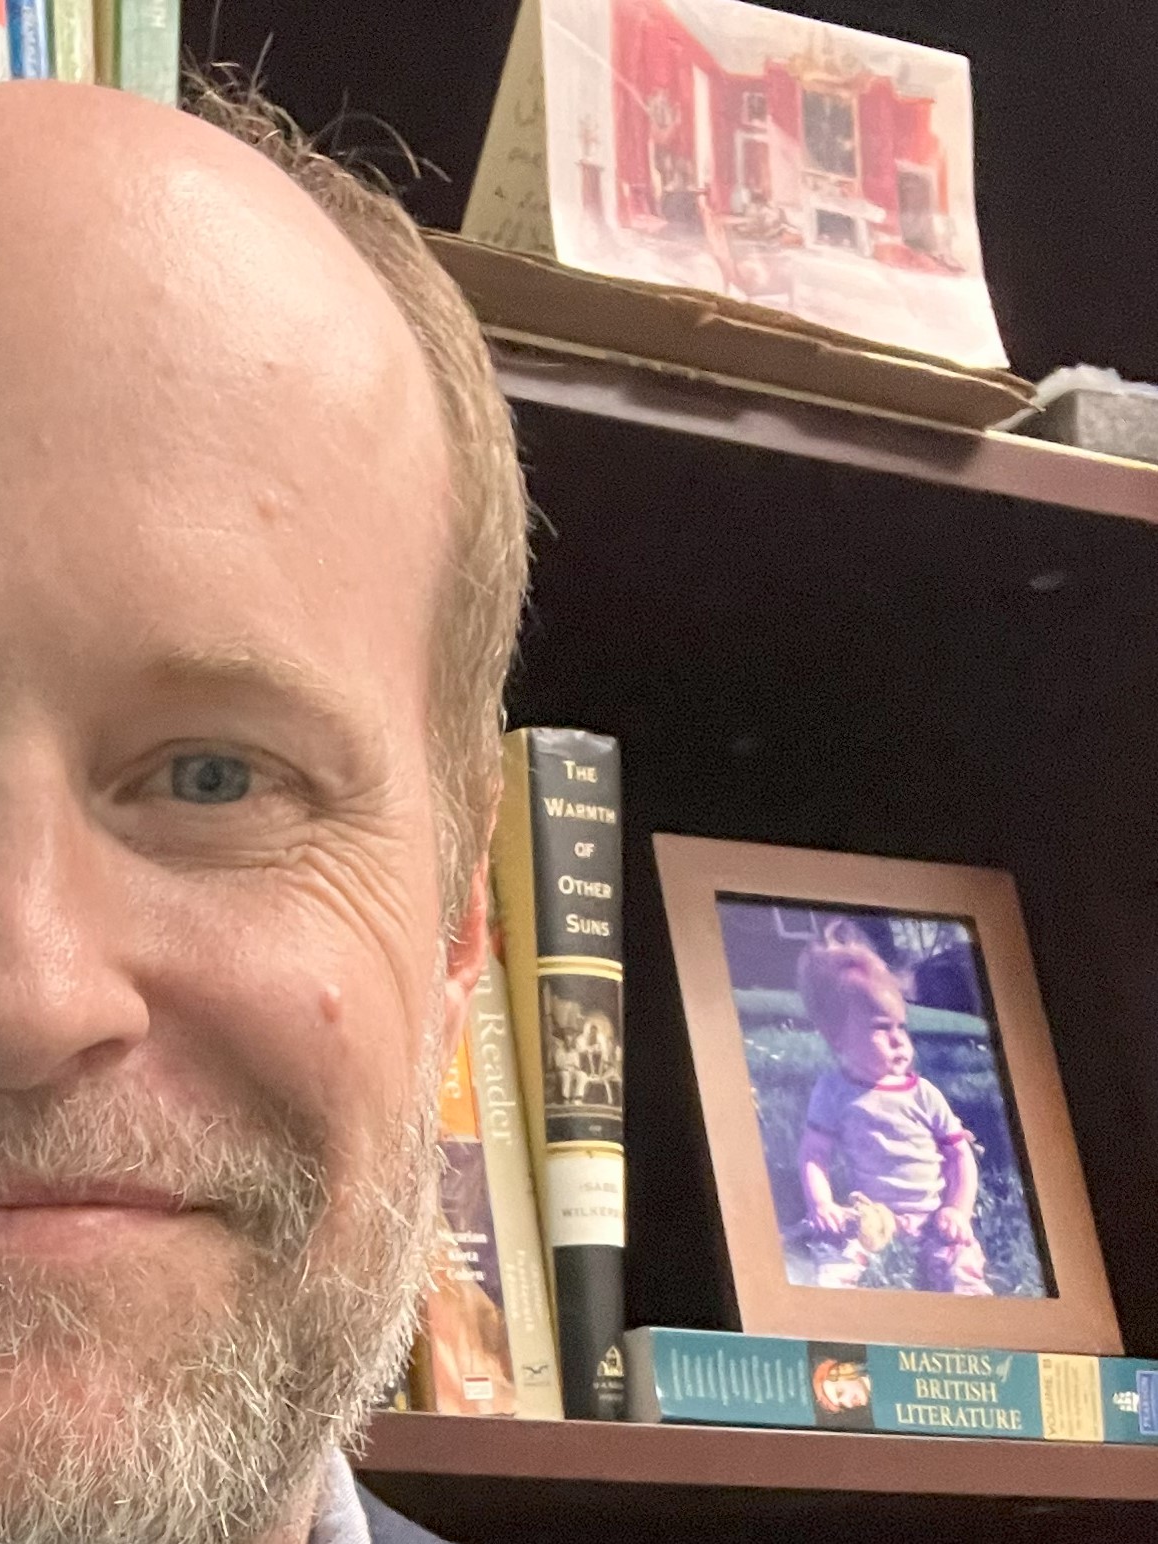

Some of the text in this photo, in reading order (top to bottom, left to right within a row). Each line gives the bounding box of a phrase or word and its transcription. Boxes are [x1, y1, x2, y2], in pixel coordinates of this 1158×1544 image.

[478, 1013, 517, 1146] Reader
[898, 1351, 1014, 1384] MASTERS of
[915, 1378, 999, 1403] BRITISH
[895, 1403, 1023, 1431] LITERATURE
